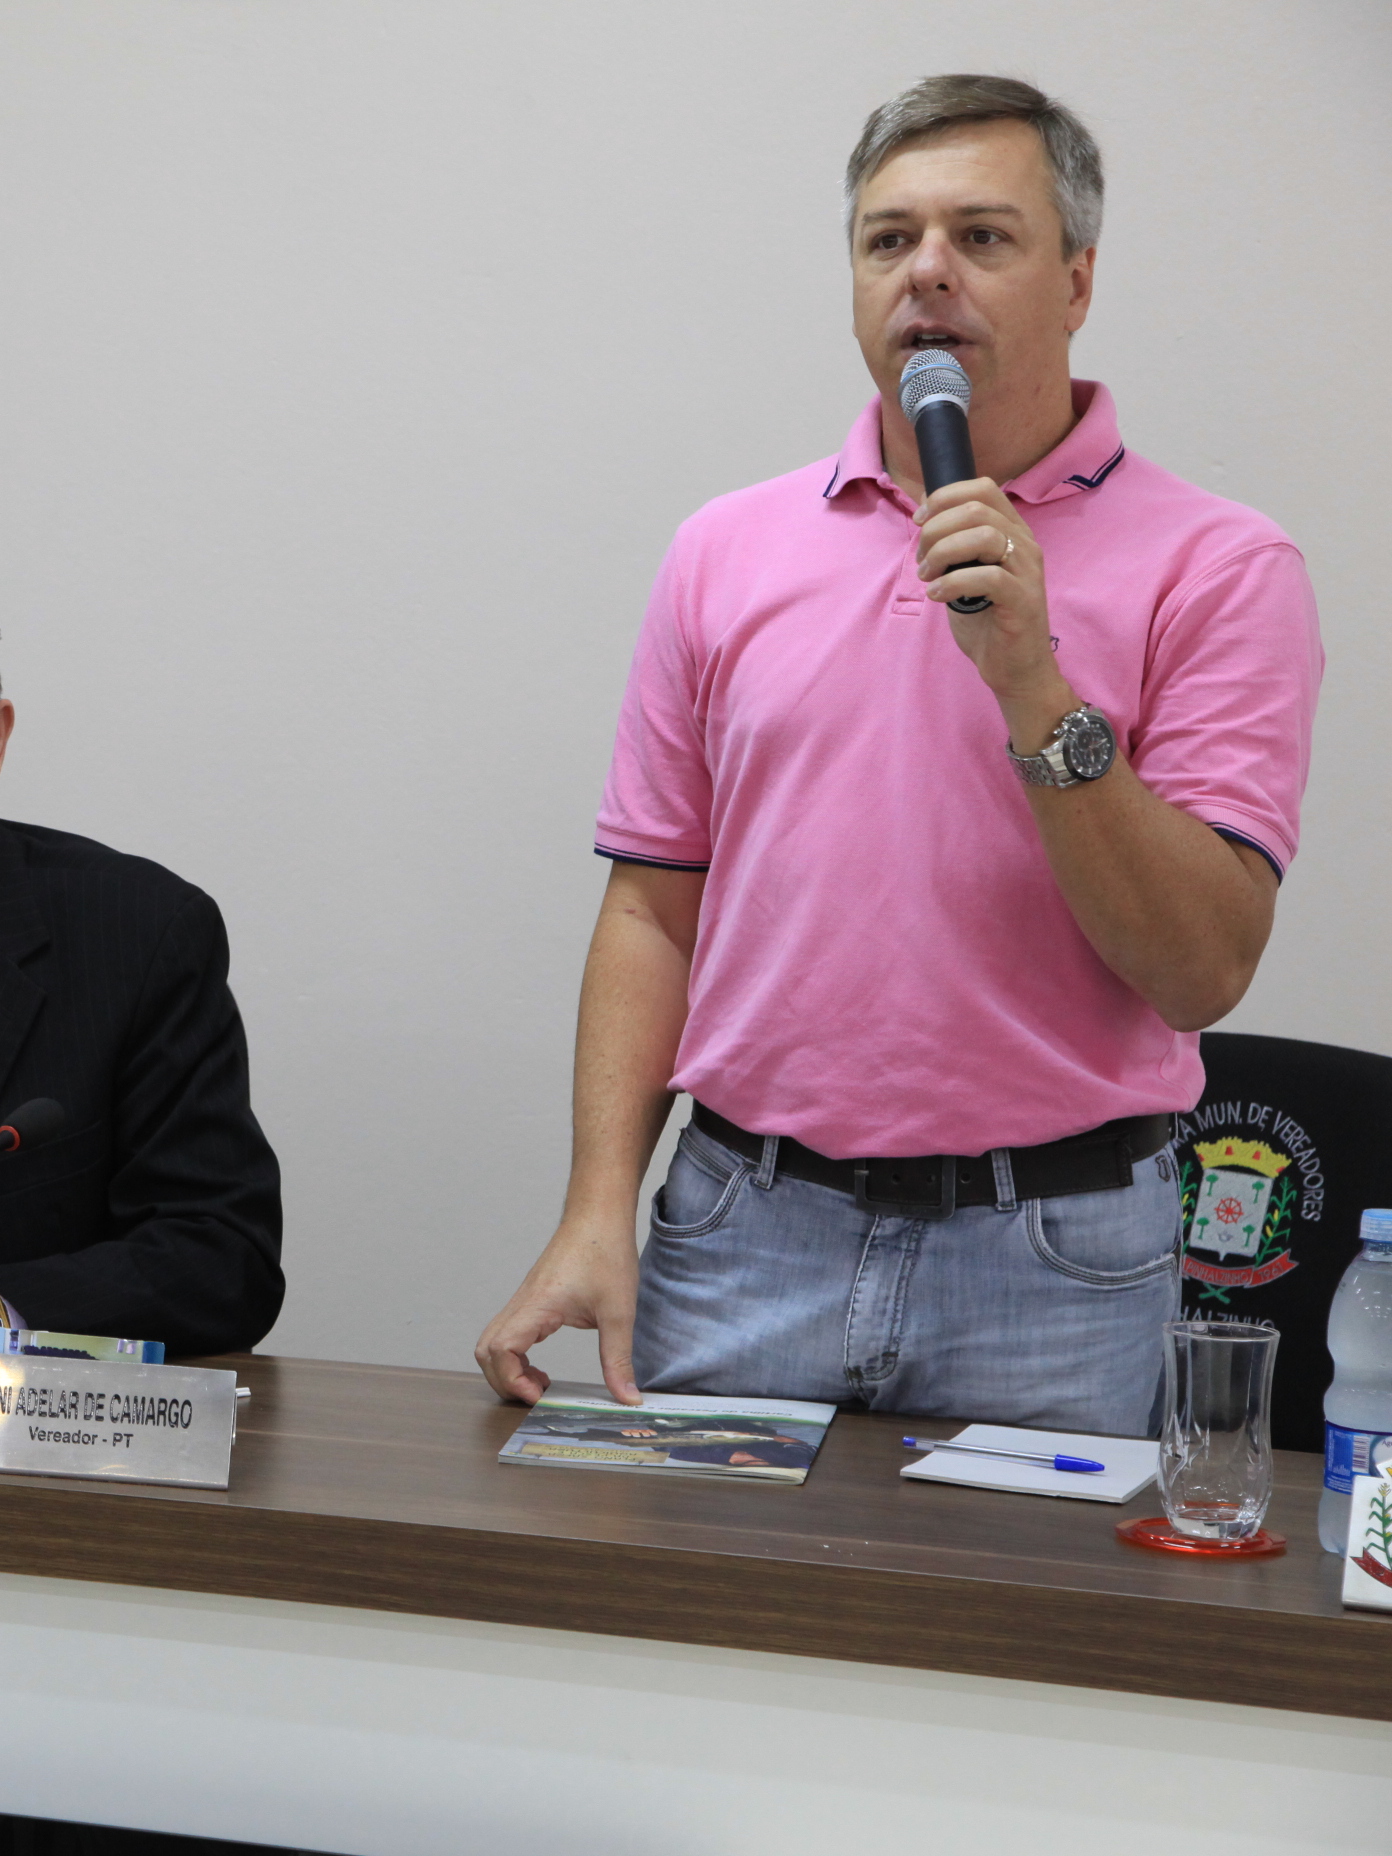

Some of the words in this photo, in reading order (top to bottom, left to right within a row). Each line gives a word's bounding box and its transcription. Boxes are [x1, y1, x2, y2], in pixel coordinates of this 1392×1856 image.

[1193, 1101, 1242, 1132] MUN.
[1248, 1102, 1273, 1131] DE
[1272, 1110, 1325, 1222] VEREADORES
[1187, 1261, 1248, 1282] PINHALZINHO
[1258, 1262, 1285, 1280] 1961
[15, 1386, 79, 1420] ADELAR
[83, 1391, 106, 1422] DE
[109, 1393, 193, 1430] CAMARGO
[28, 1425, 98, 1446] Vereador
[112, 1432, 134, 1449] PT
